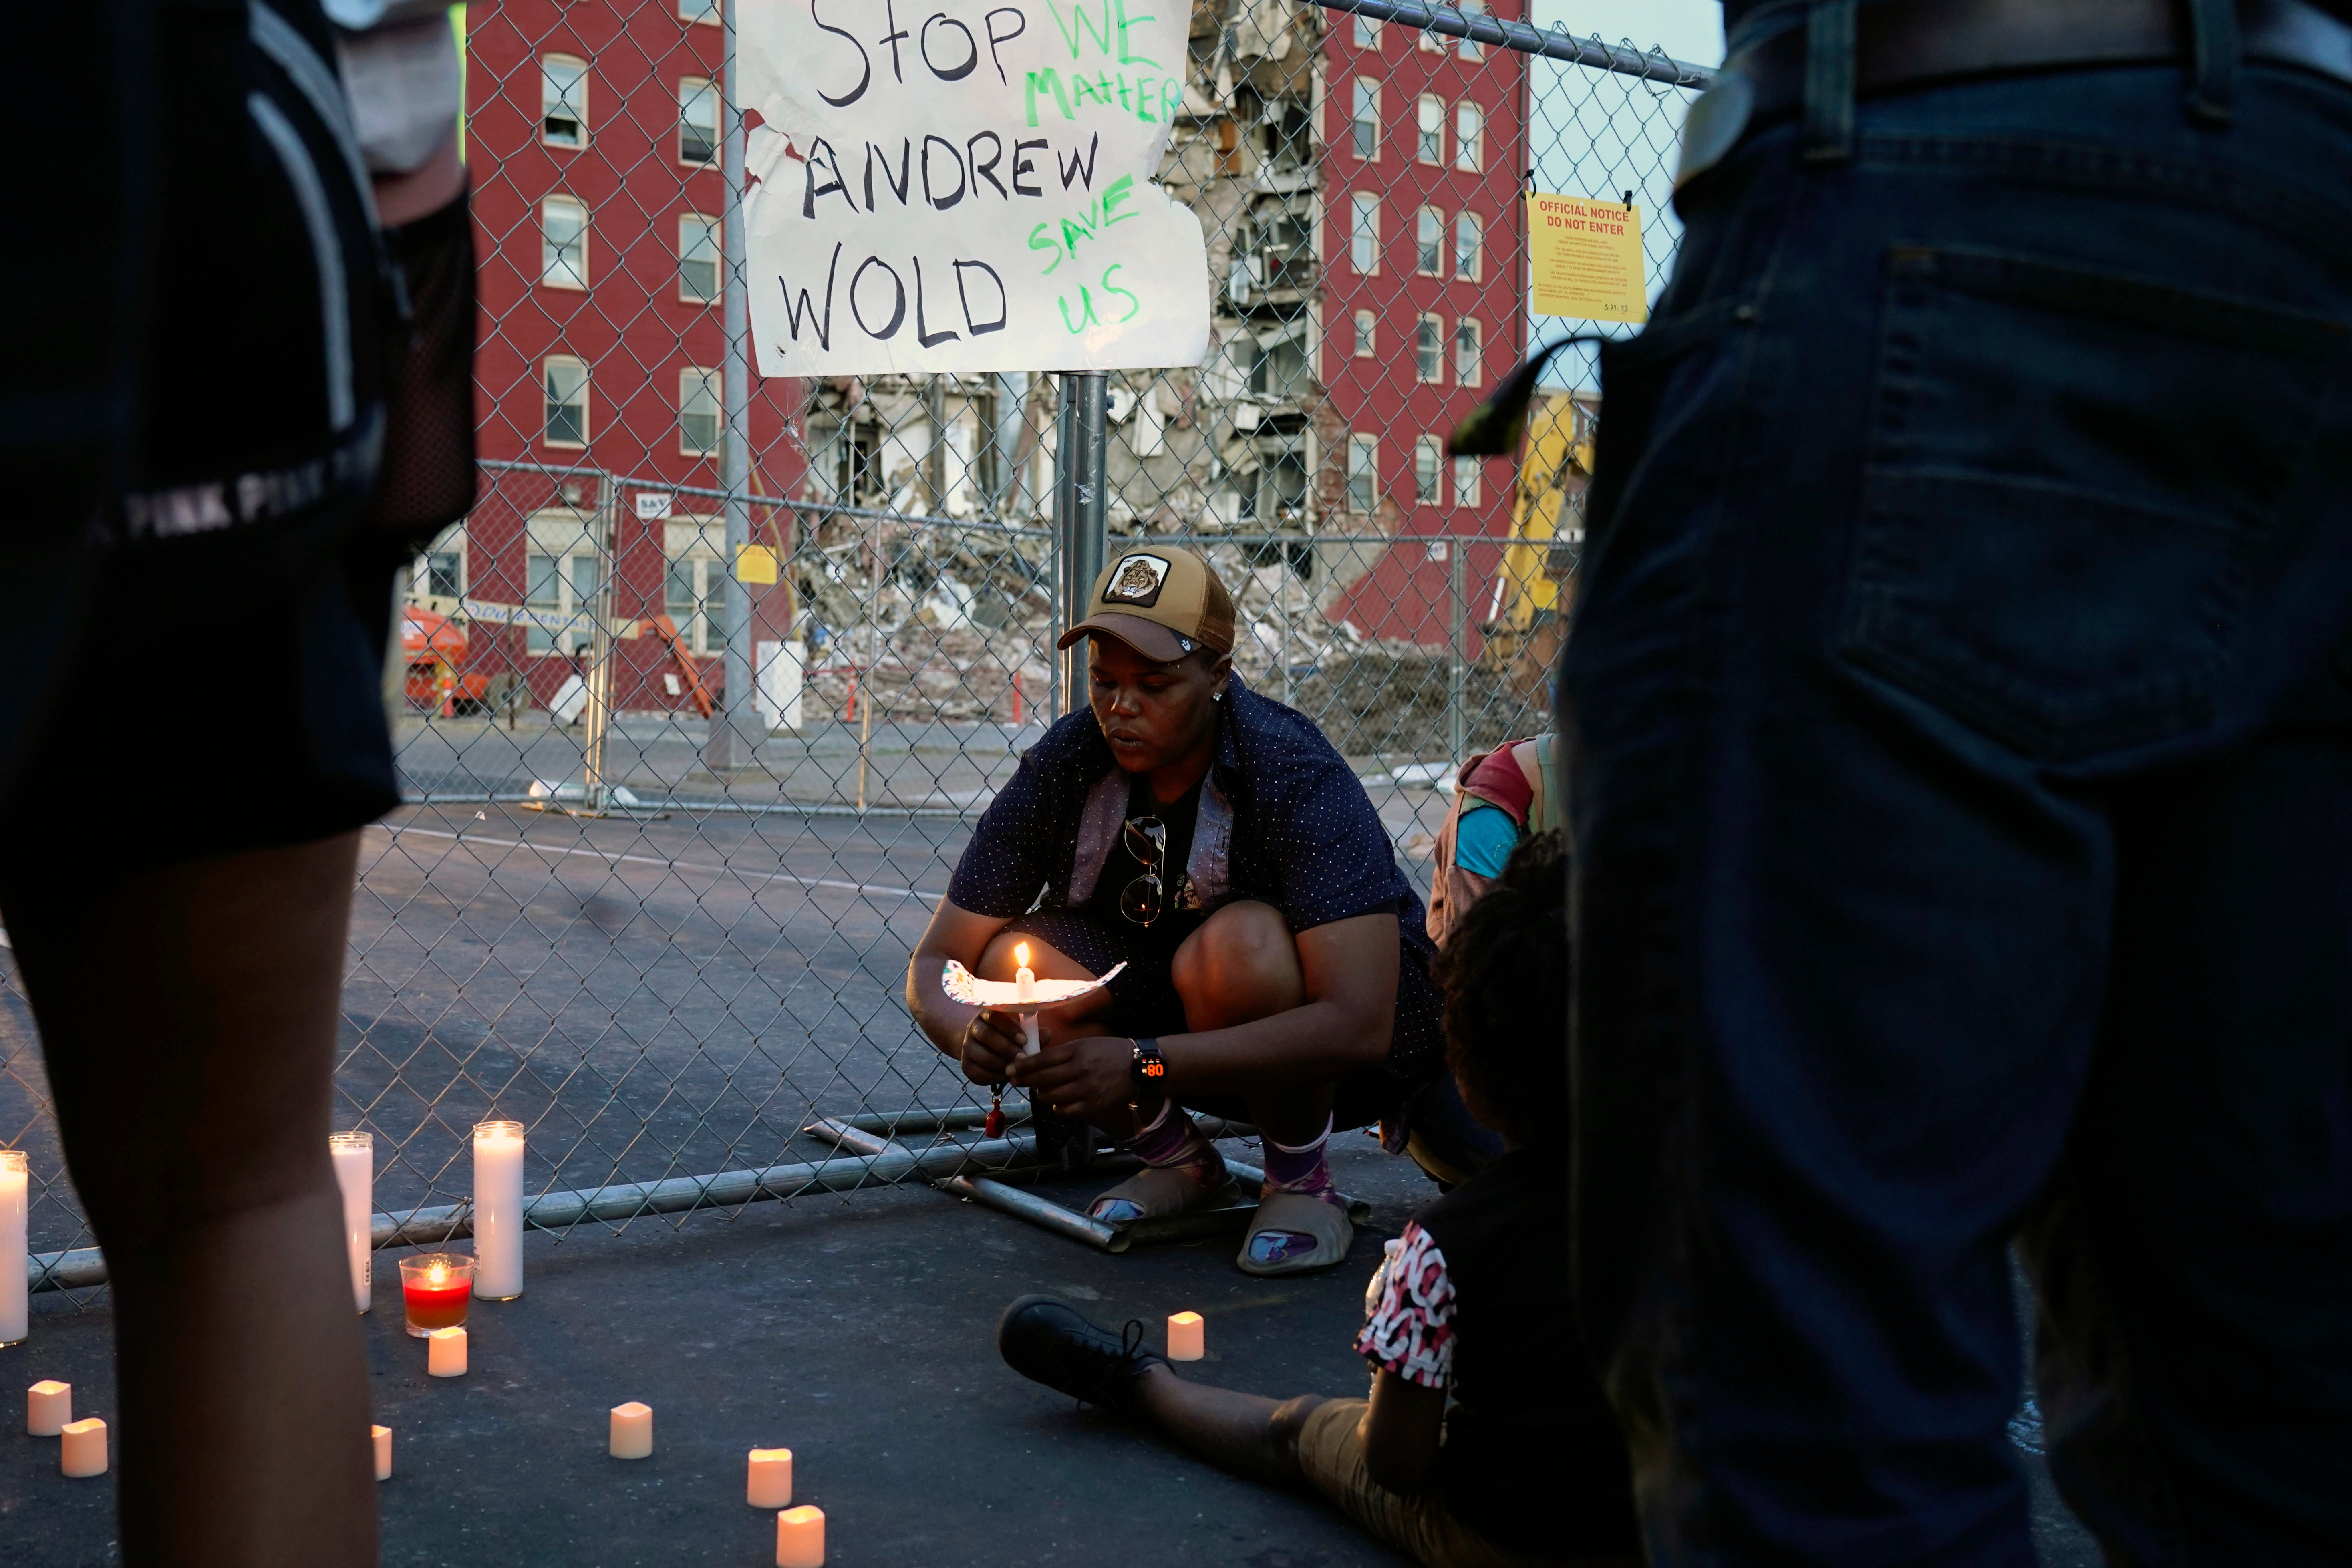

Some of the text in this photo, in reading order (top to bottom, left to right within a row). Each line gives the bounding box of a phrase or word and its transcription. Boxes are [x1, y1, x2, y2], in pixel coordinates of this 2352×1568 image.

[1051, 0, 1162, 70] WE
[803, 131, 1098, 219] ANDREW
[1028, 174, 1140, 275] SAVE
[1540, 201, 1629, 222] OFFICIAL NOTICE
[1547, 216, 1624, 236] DO NOT ENTER
[779, 241, 1007, 352] WOLD
[1058, 263, 1140, 334] US
[1147, 1064, 1164, 1077] 80
